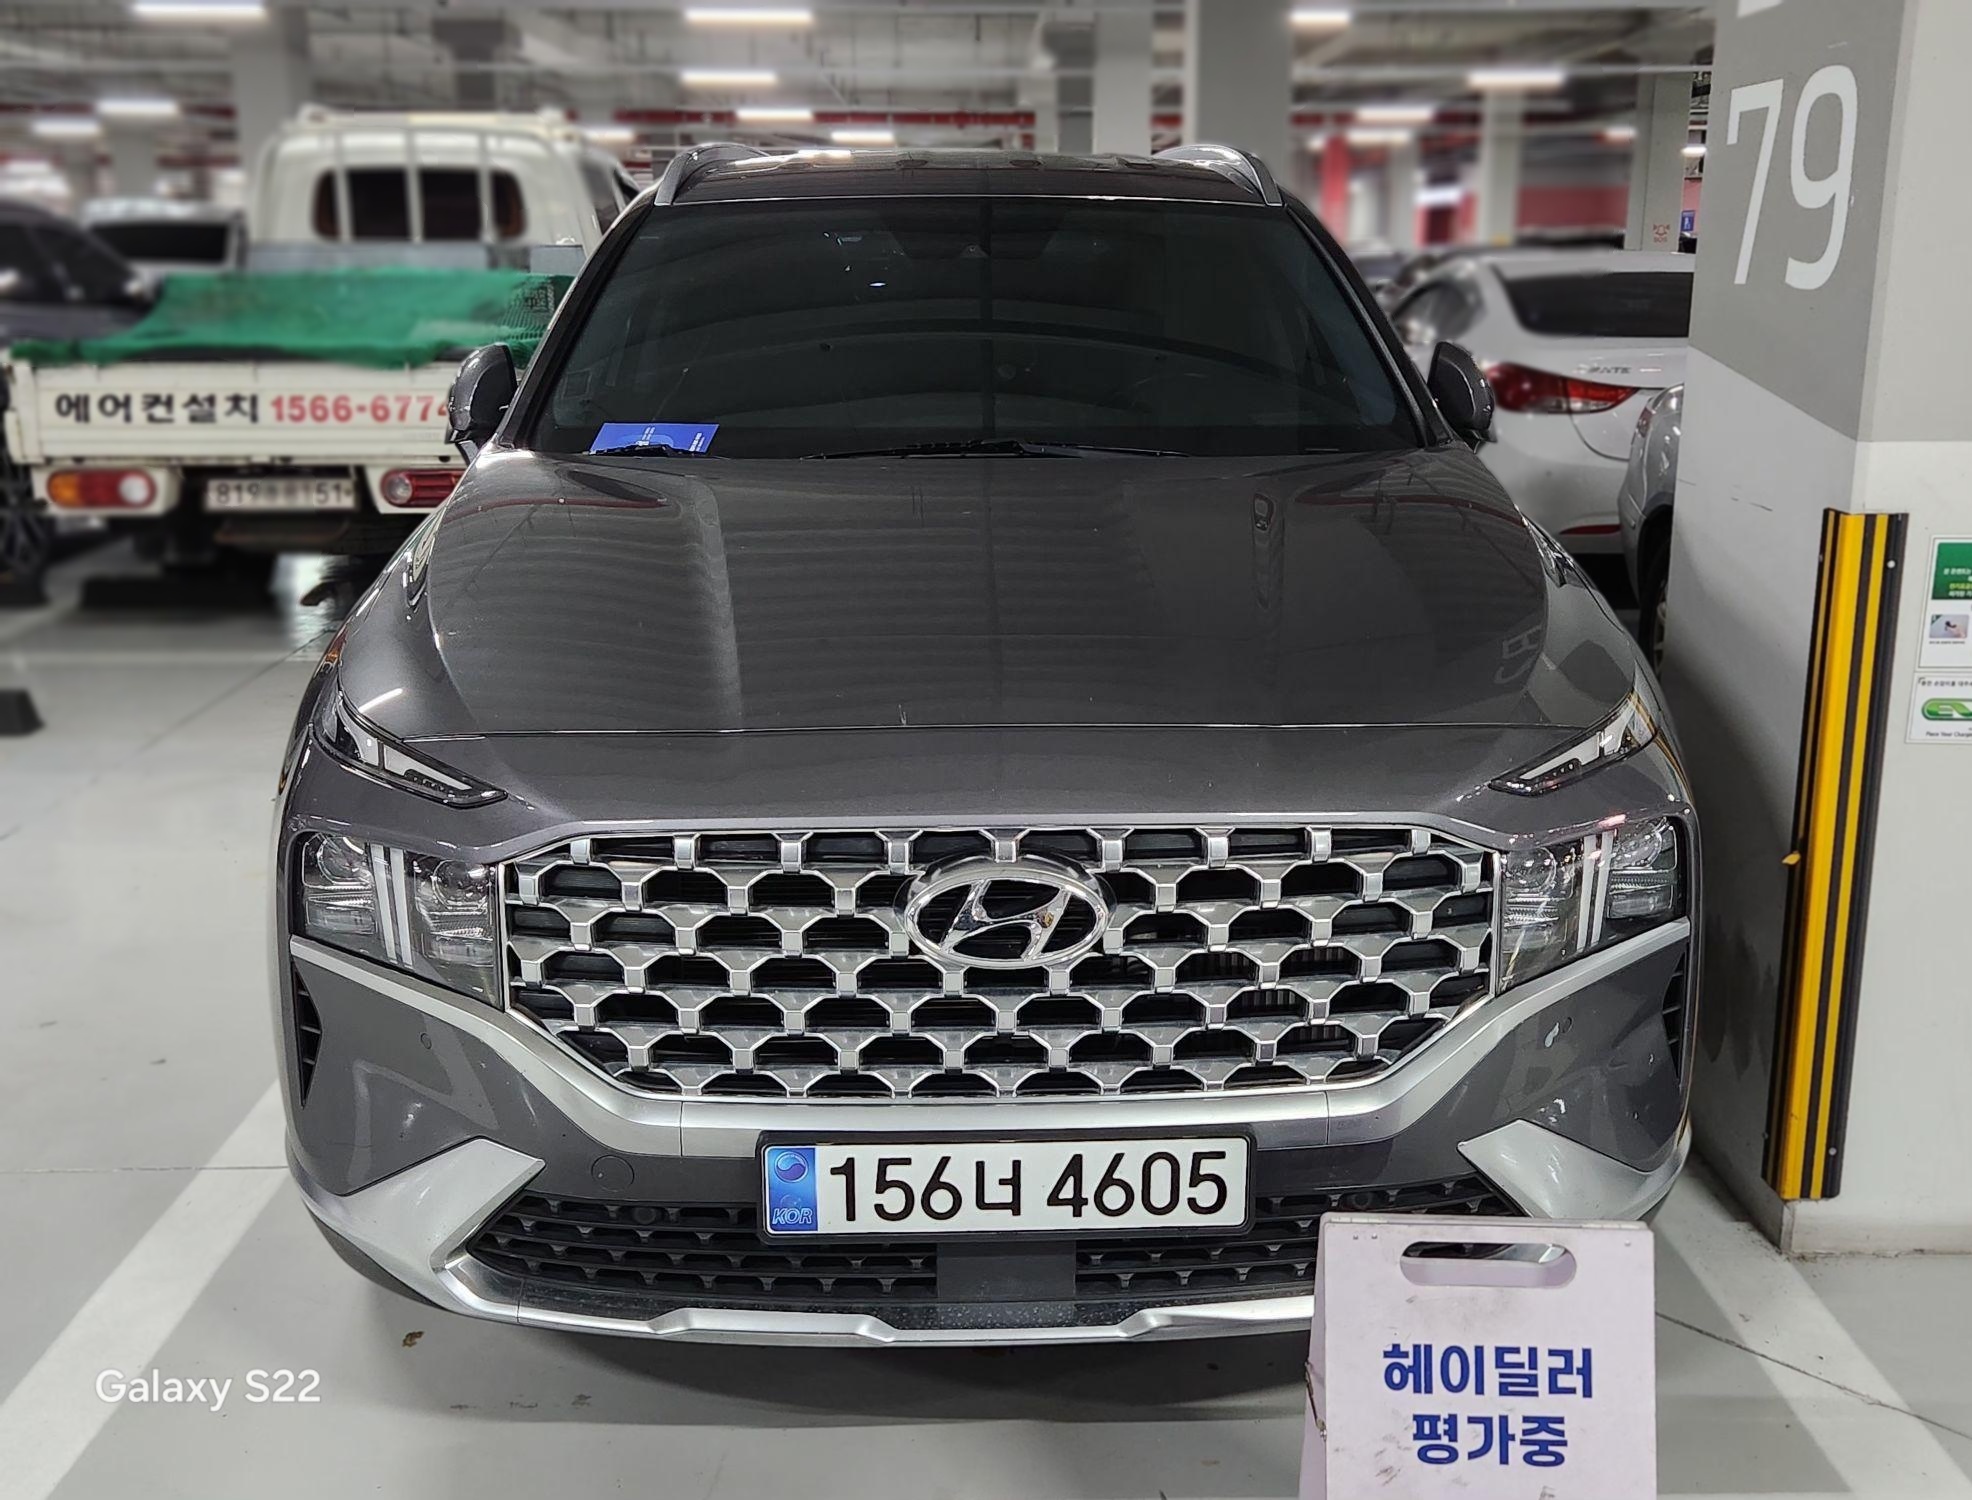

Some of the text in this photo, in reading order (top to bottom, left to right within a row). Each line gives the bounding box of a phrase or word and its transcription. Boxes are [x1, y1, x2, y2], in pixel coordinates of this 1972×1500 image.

[1726, 64, 1858, 290] 79
[55, 393, 260, 423] 에어컨설치
[1046, 1151, 1228, 1218] 4605
[772, 1207, 813, 1225] KOR
[1383, 1343, 1593, 1398] 헤이딜러
[1412, 1413, 1569, 1467] 평가중
